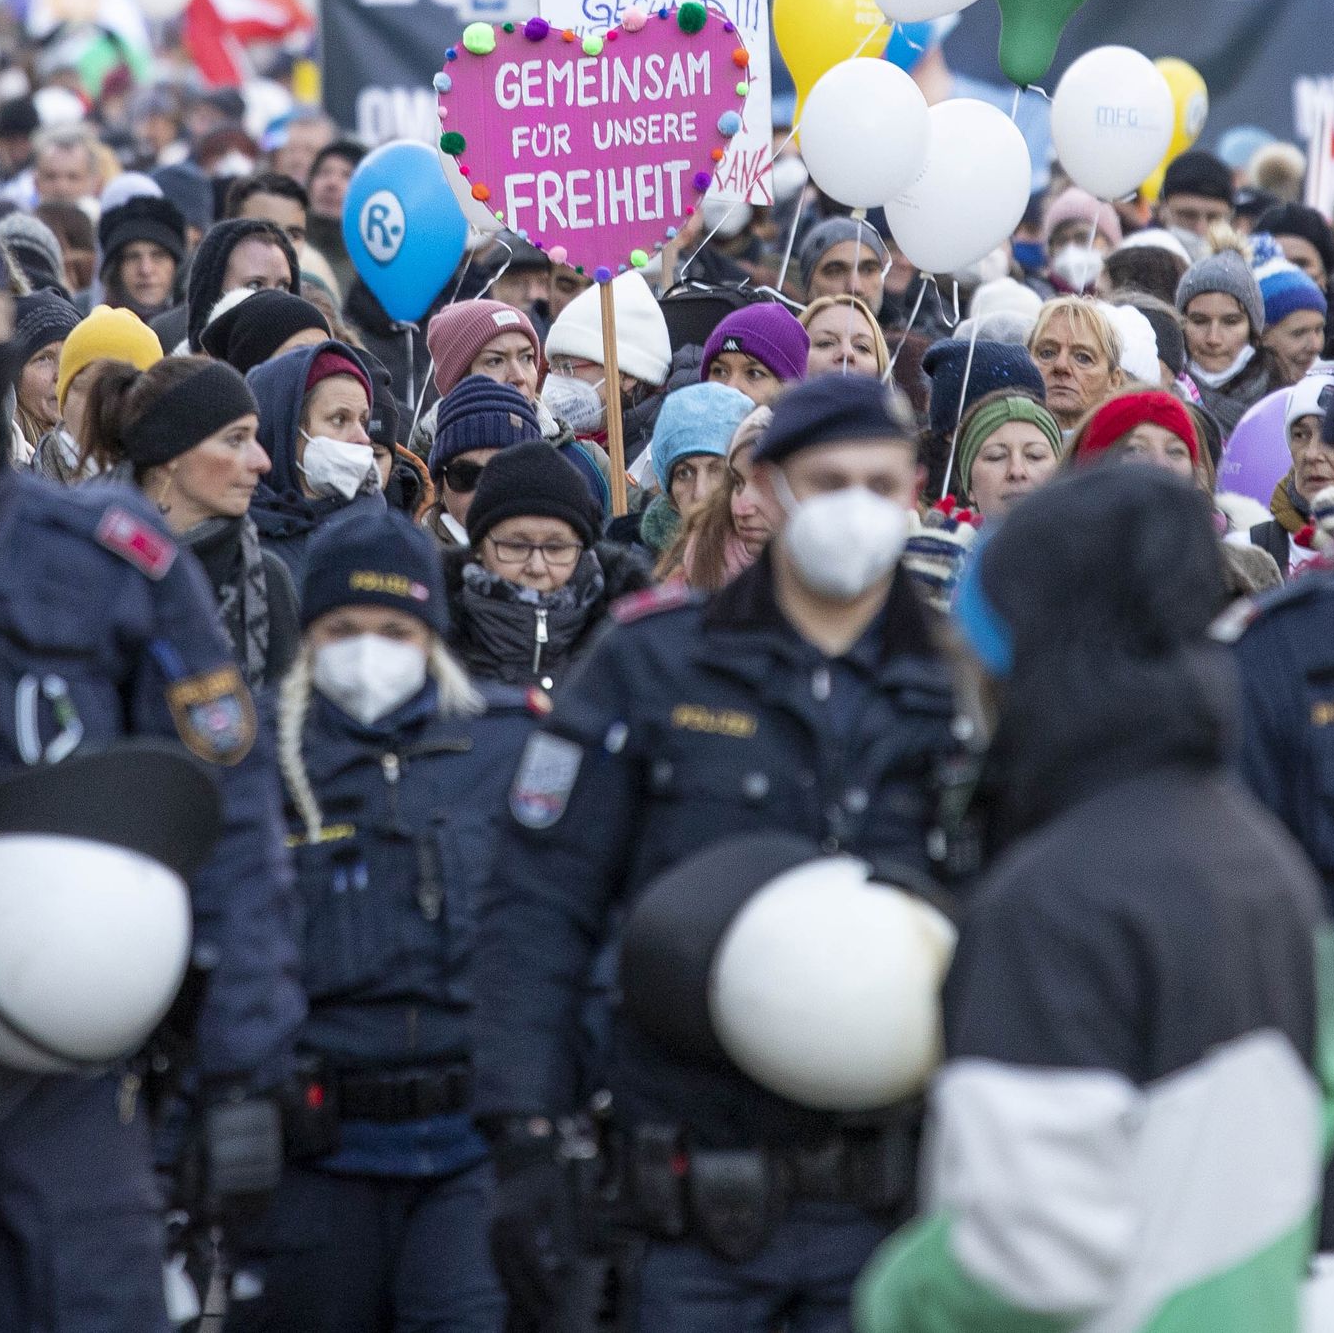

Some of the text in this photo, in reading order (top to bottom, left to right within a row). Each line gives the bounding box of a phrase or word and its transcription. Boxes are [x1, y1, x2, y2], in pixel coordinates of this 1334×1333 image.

[495, 50, 711, 110] GEMEINSAM
[511, 111, 698, 159] FÜR UNSERE
[503, 160, 692, 233] FREIHEIT
[714, 143, 774, 205] RANK
